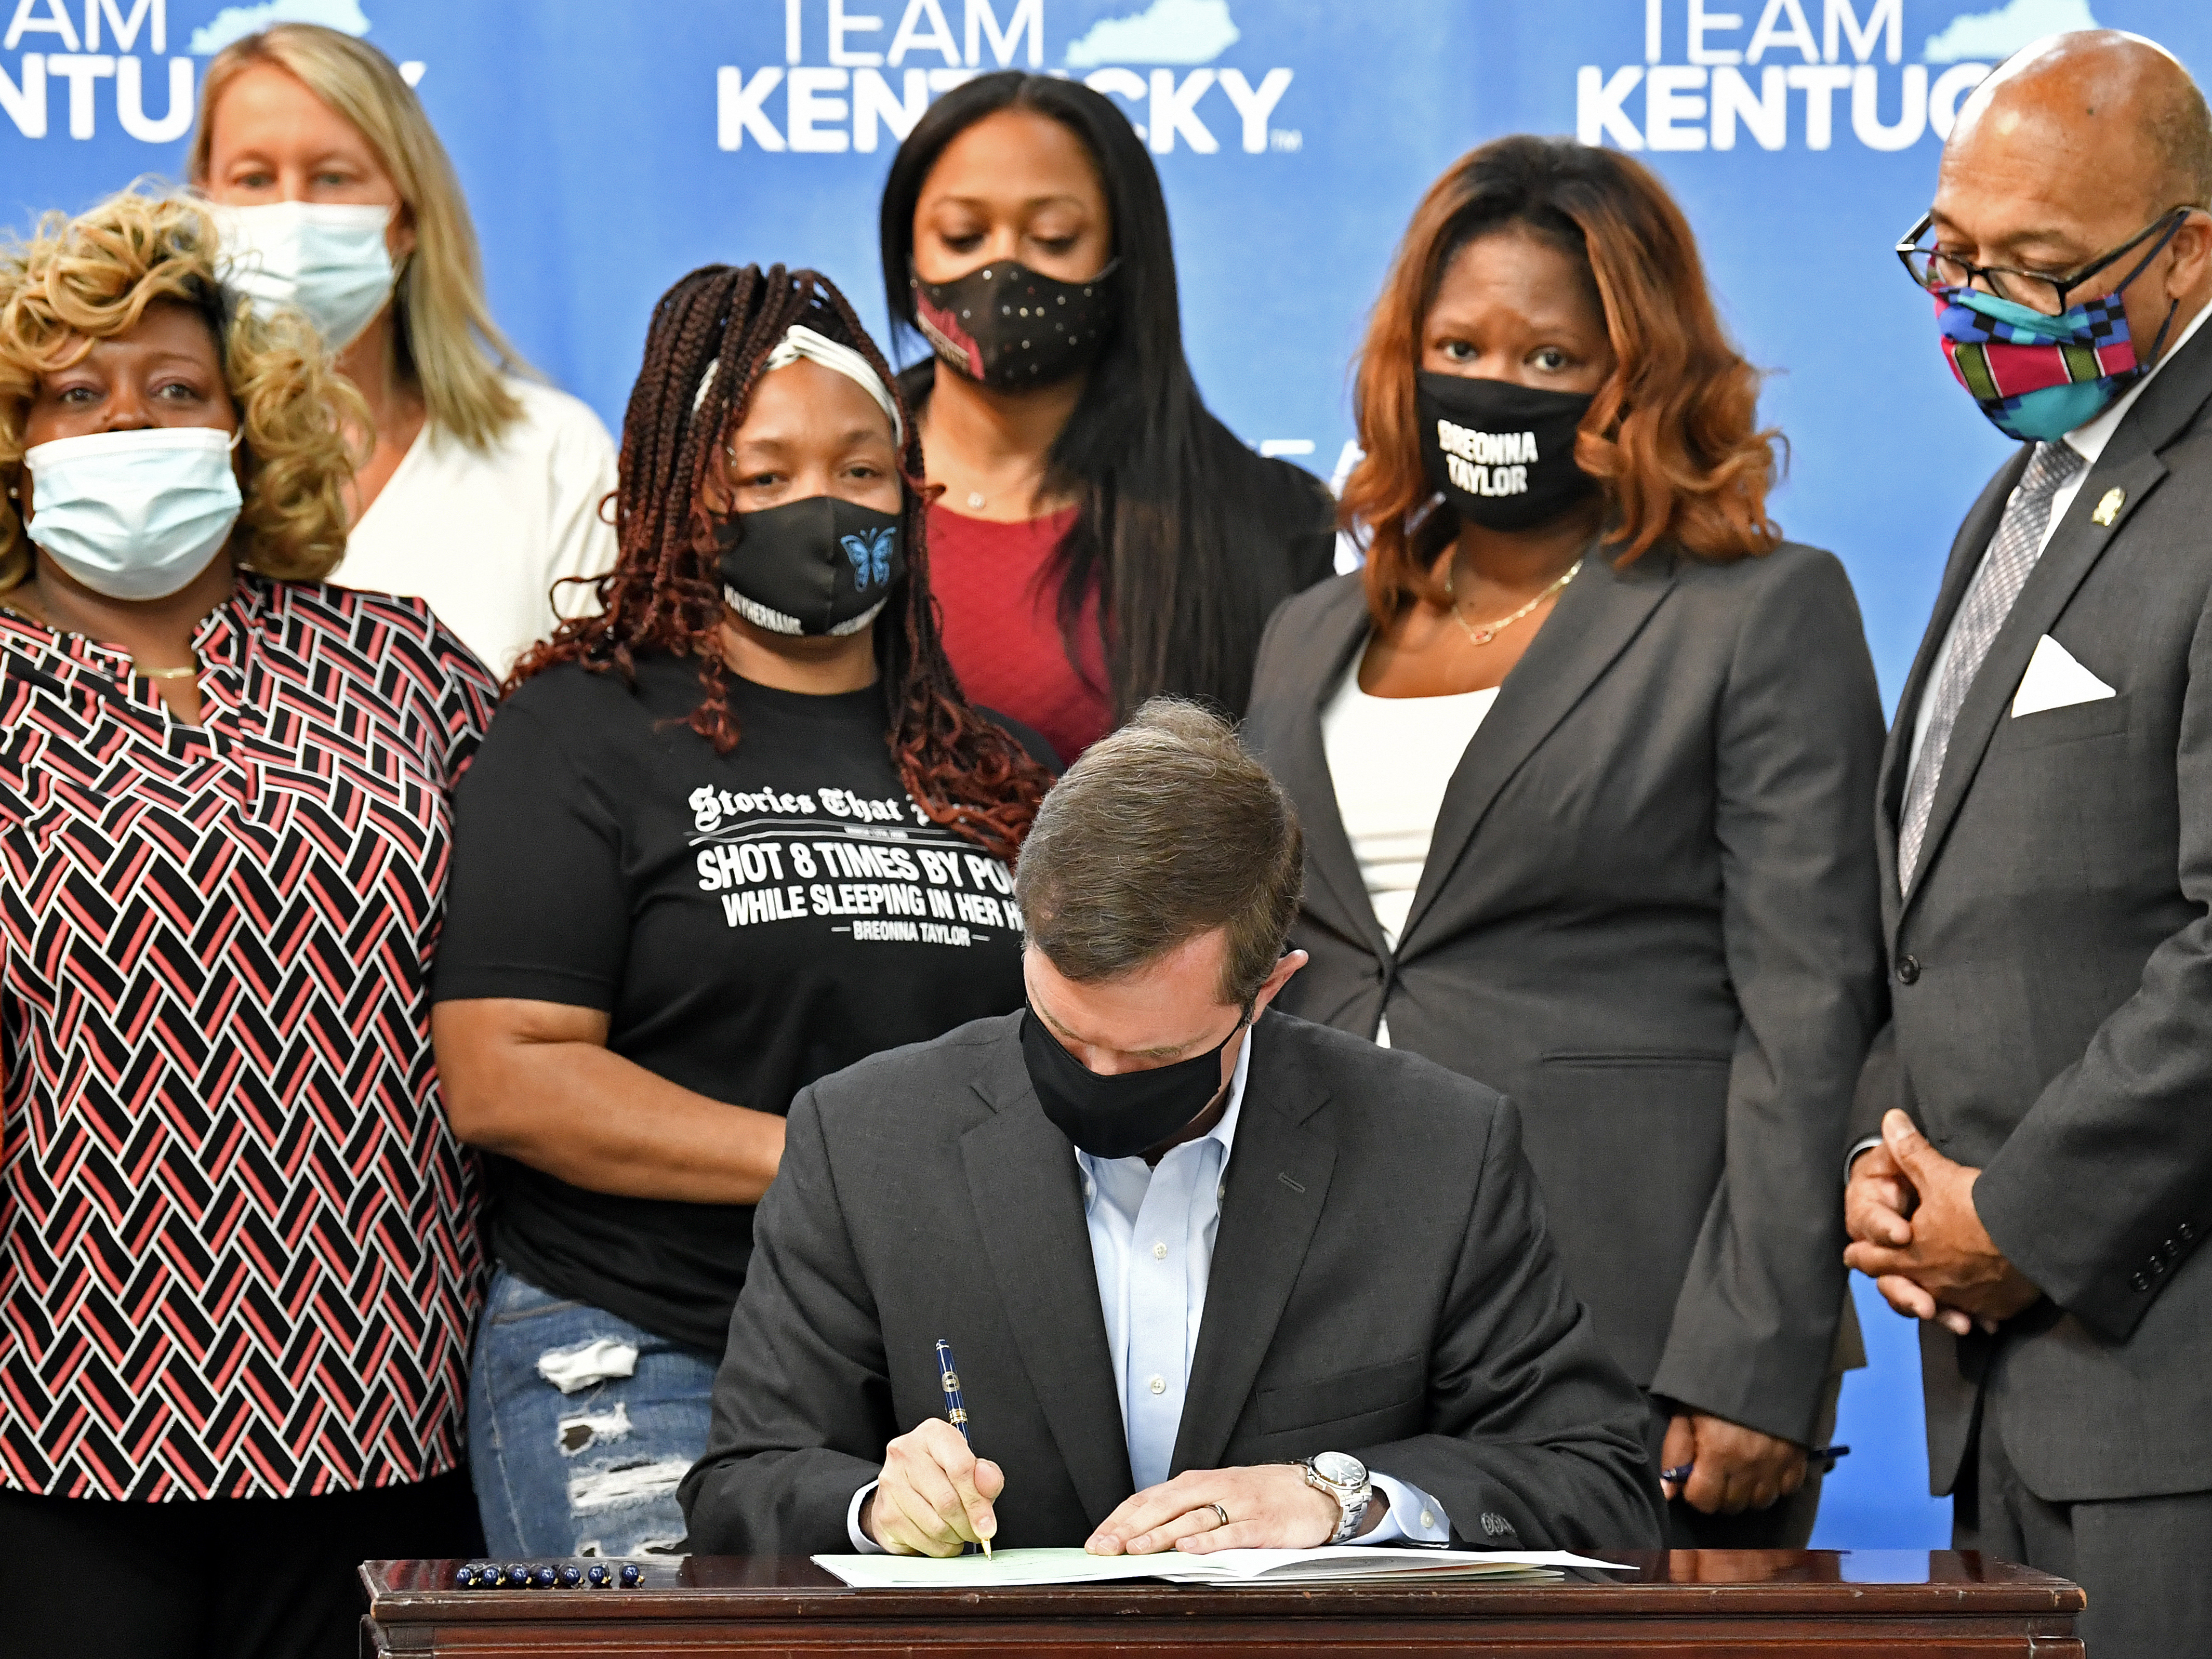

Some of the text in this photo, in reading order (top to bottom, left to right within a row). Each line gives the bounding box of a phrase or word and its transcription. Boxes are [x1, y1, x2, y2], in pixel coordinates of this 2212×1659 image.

[1437, 419, 1539, 466] BREONNA
[1446, 453, 1528, 497] TAYLOR
[688, 784, 817, 832] Stories
[818, 788, 904, 822] That
[697, 842, 784, 891] SHOT
[790, 842, 817, 878] 8
[812, 843, 920, 881] TIMES
[916, 848, 963, 887] BY
[721, 885, 809, 927] WHILE
[810, 884, 926, 923] SLEEPING
[926, 888, 956, 920] IN
[952, 892, 1005, 928] HER
[852, 920, 972, 947] BREONNA TAYLOR
